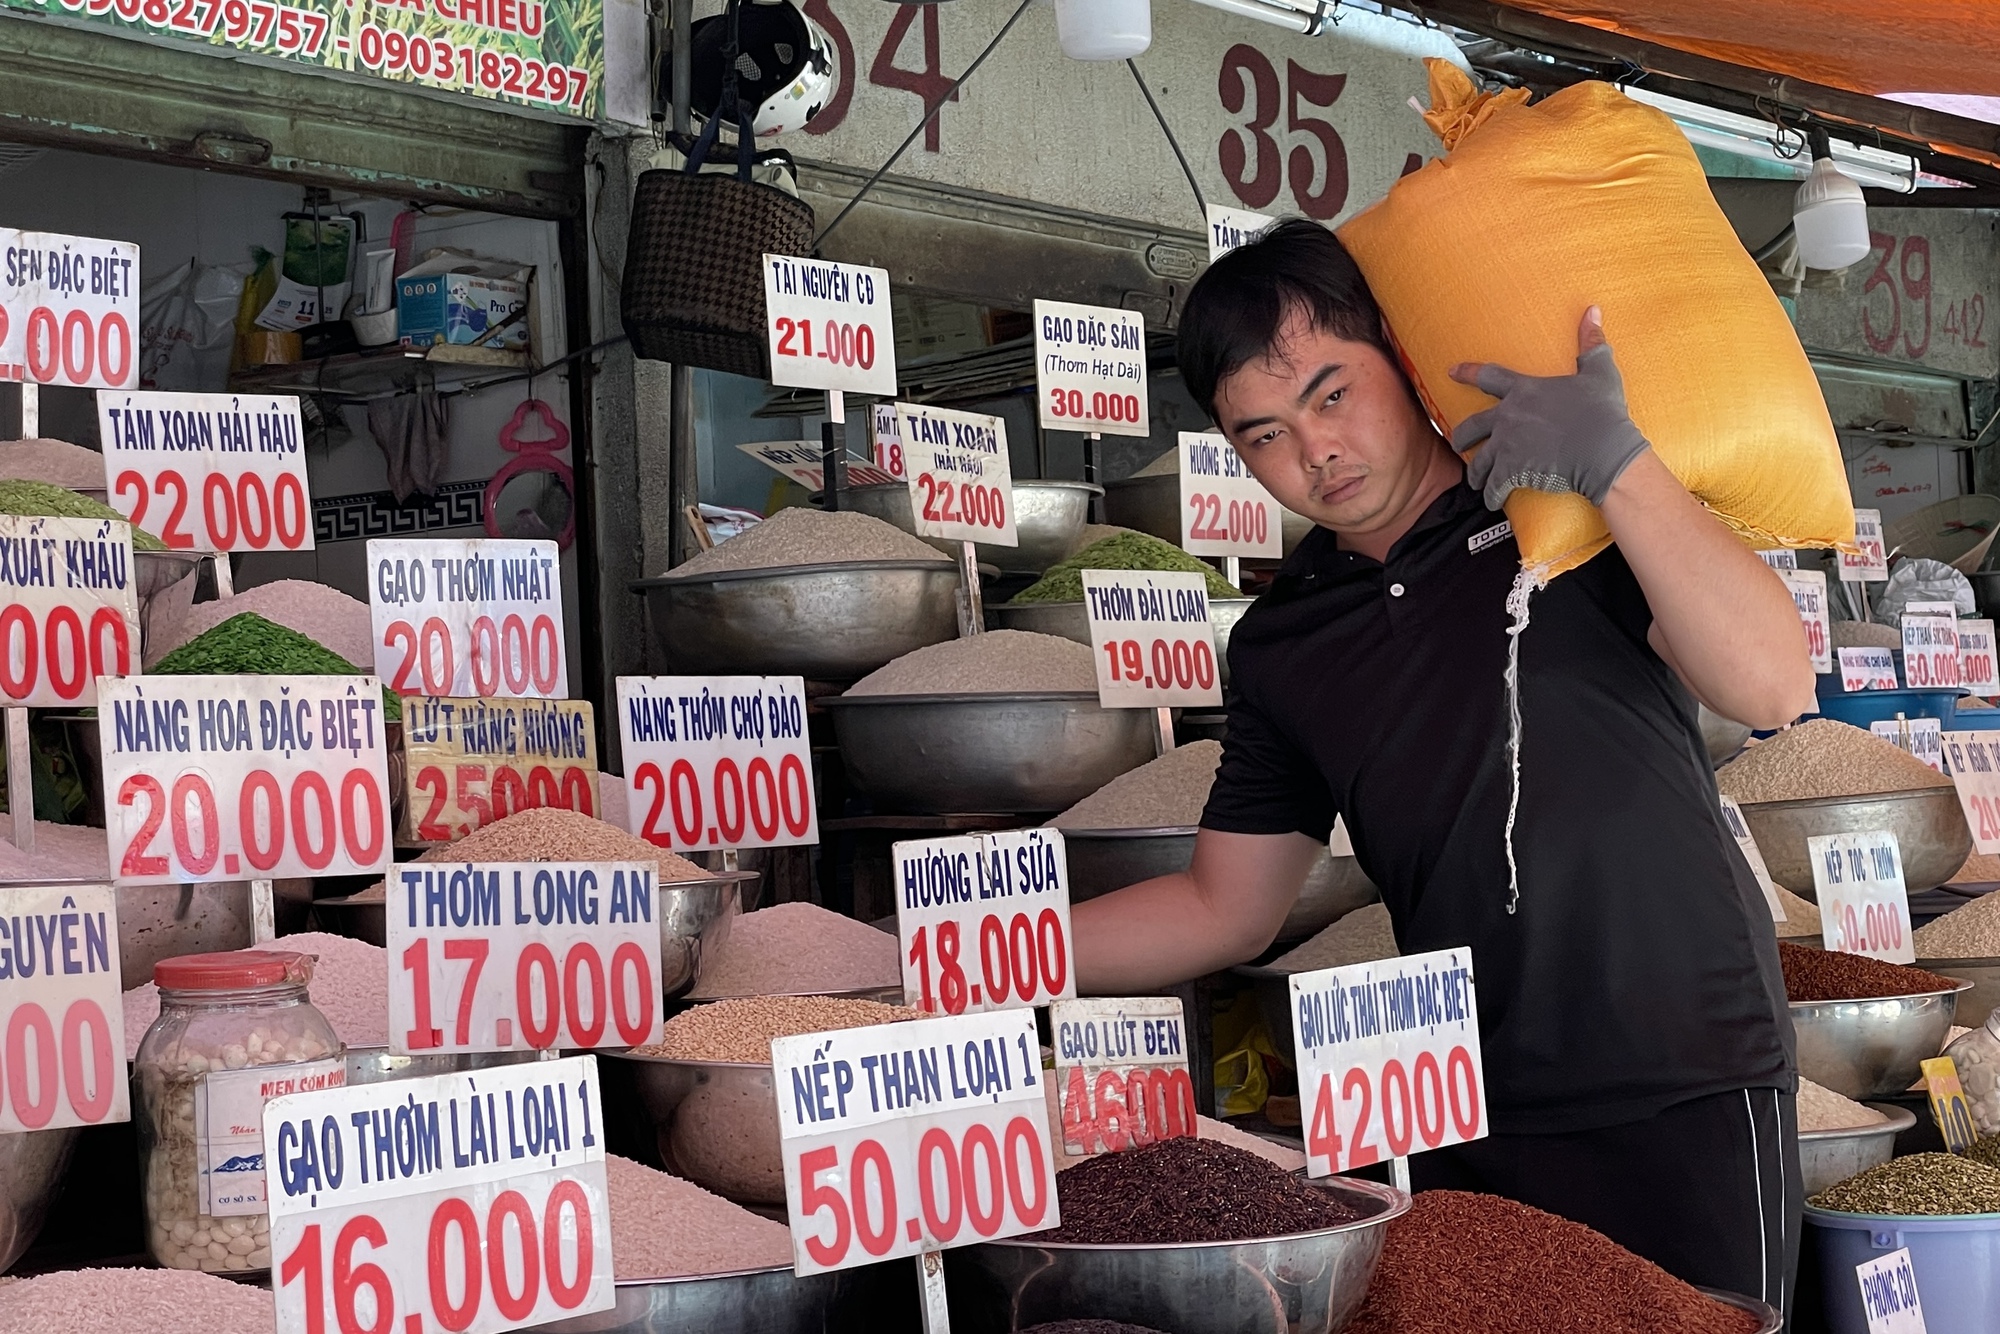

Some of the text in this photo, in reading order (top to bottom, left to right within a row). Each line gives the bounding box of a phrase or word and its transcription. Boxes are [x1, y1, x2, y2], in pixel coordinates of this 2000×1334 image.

[360, 27, 588, 106] 0903182297
[1218, 43, 1349, 220] 35
[7, 244, 132, 304] SEN ĐẶC BIỆT
[773, 257, 874, 305] TÀI NGUYÊN CĐ
[1863, 231, 1932, 359] 39
[490, 299, 506, 313] Pro
[1043, 314, 1140, 351] GẠO ĐẶC SẢN
[1045, 354, 1141, 384] (Thơm Hạt Dài)
[109, 397, 298, 460] TÁM XOAN HẢI HẬU
[907, 411, 998, 454] TÁM XOAN
[1050, 388, 1140, 423] 30.000
[933, 448, 957, 471] (HẢI
[1189, 439, 1220, 476] HƯƠNG
[917, 472, 1006, 529] 22.000
[1190, 493, 1268, 545] 22.000
[0, 518, 127, 590] XUẤT KHẨU
[1472, 523, 1507, 545] TOTO
[378, 547, 553, 607] GẠO THƠM NHẬT
[1087, 579, 1207, 622] THƠM ĐÀI LOAN
[1103, 638, 1215, 691] 19.000
[1906, 653, 1958, 687] 50.000
[113, 685, 376, 759] NÀNG HOA ĐẶC BIỆT
[410, 696, 587, 759] LỨT NÀNG HƯƠNG
[629, 684, 677, 742] NÀNG
[731, 688, 764, 748] CHỢ
[768, 684, 802, 739] ĐÀO
[117, 767, 385, 877] 20.000
[634, 753, 810, 849] 20.000
[903, 831, 1059, 909] HƯƠNG LÀI SỮA
[1825, 838, 1896, 885] NẾP TÓC THƠM
[401, 863, 652, 928] THƠM LONG AN
[1832, 898, 1902, 952] 30.000
[909, 907, 1067, 1016] 18.000
[403, 938, 654, 1050] 17.000
[1299, 958, 1470, 1059] GẠO LỨC THÁI THƠM ĐẶC BIỆT
[0, 998, 115, 1129] 00
[1060, 1010, 1181, 1066] GẠO LỨT ĐEN
[261, 1080, 295, 1097] MEN
[791, 1032, 1036, 1125] NẾP THAN LOẠI 1
[1309, 1045, 1480, 1174] 42000
[278, 1077, 596, 1208] GẠO THƠM LÀI LOẠI 1
[799, 1116, 1048, 1267] 50.000
[281, 1179, 594, 1334] 16.000
[1862, 1256, 1917, 1325] PHỘNG CỘI
